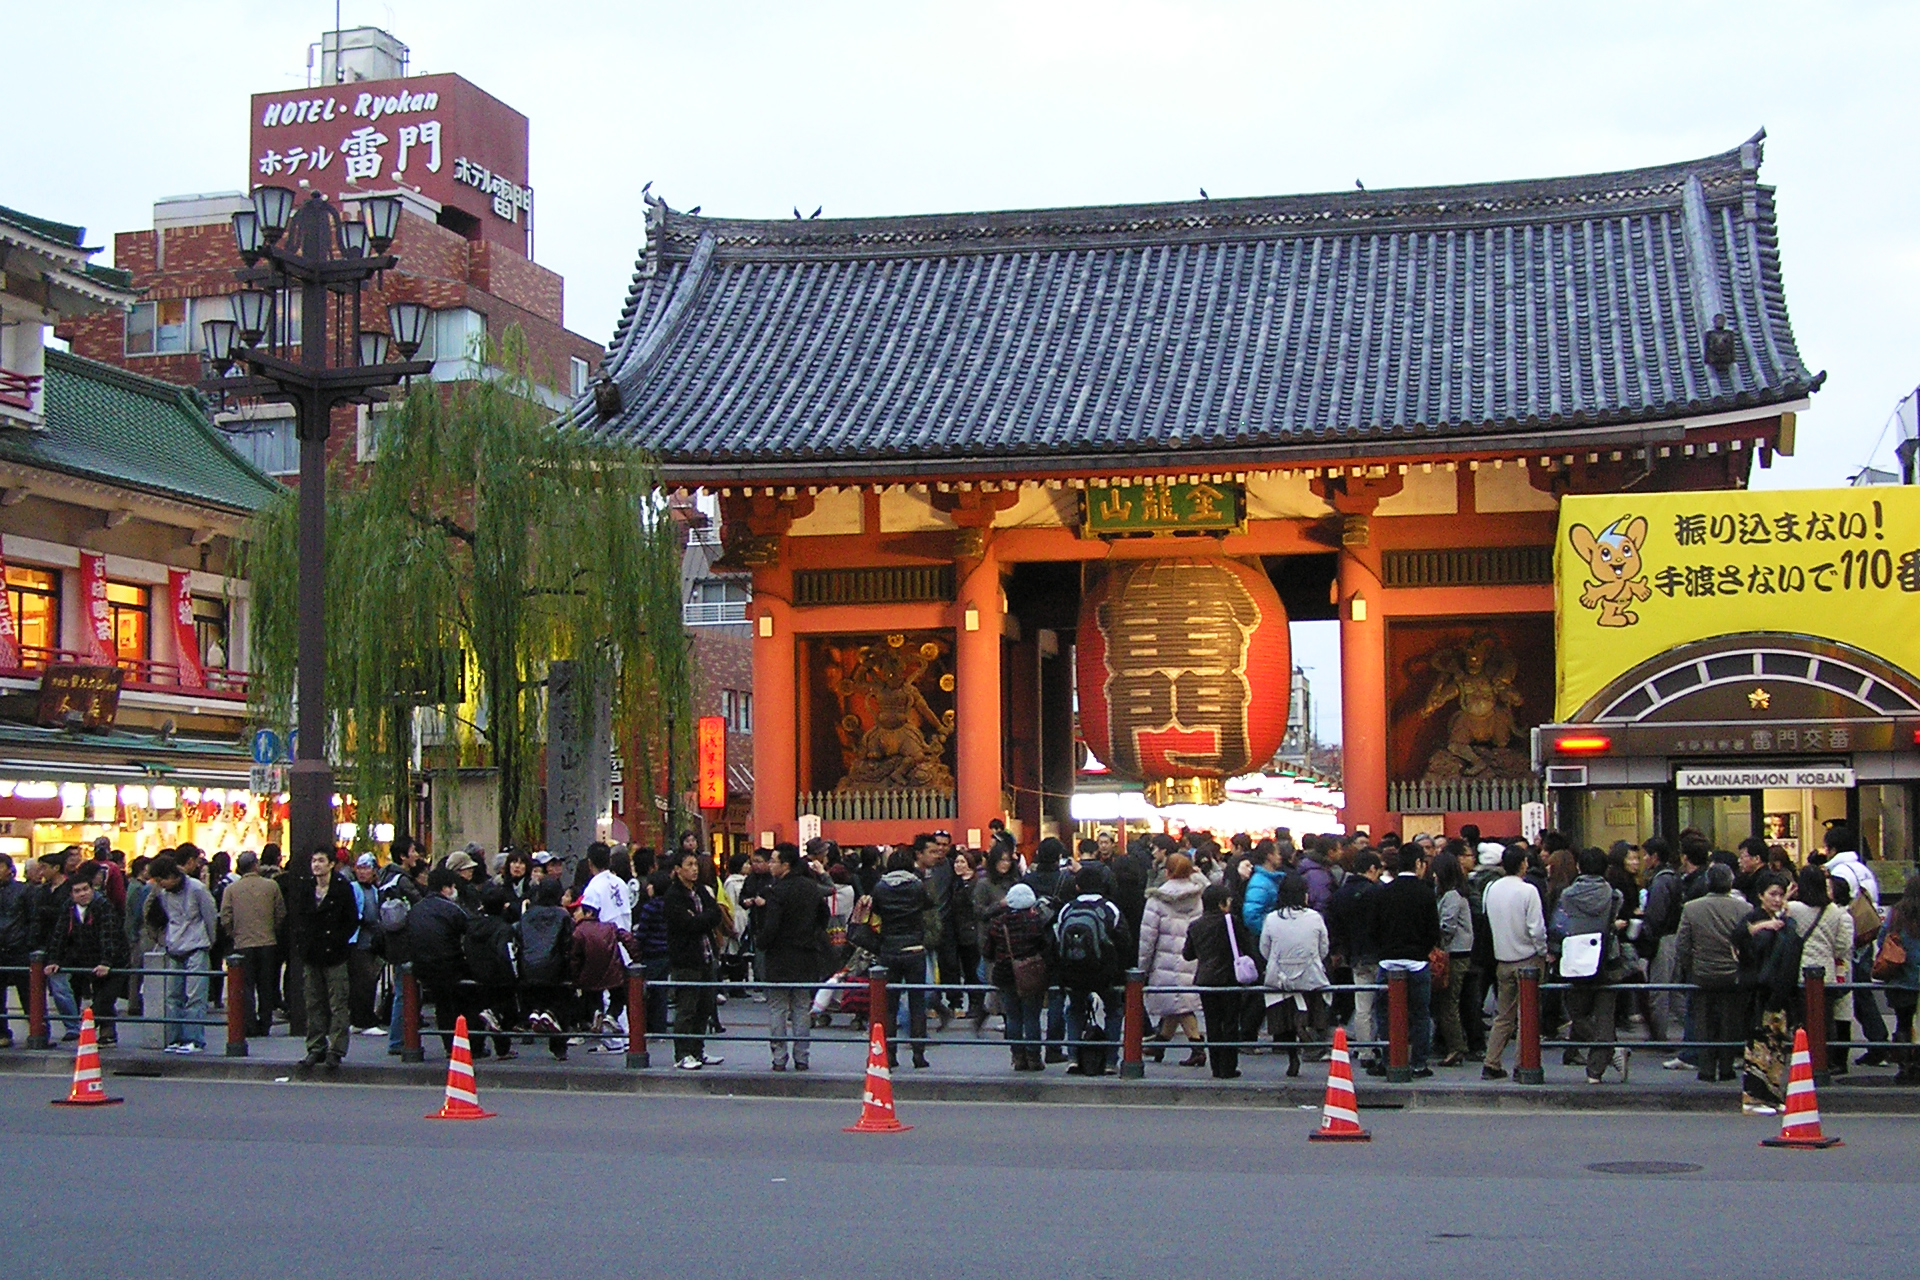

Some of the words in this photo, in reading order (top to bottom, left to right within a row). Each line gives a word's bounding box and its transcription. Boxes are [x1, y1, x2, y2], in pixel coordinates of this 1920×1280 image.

[263, 97, 336, 127] HOTEL
[354, 89, 439, 121] Ryokan
[259, 120, 442, 180] ホテル雷門
[453, 156, 533, 229] ホテル雷門
[1674, 500, 1884, 546] 振り込まない!
[1751, 728, 1849, 750] 雷門交番
[1686, 773, 1789, 786] KAMINARIMON
[1796, 772, 1845, 785] KOBAN
